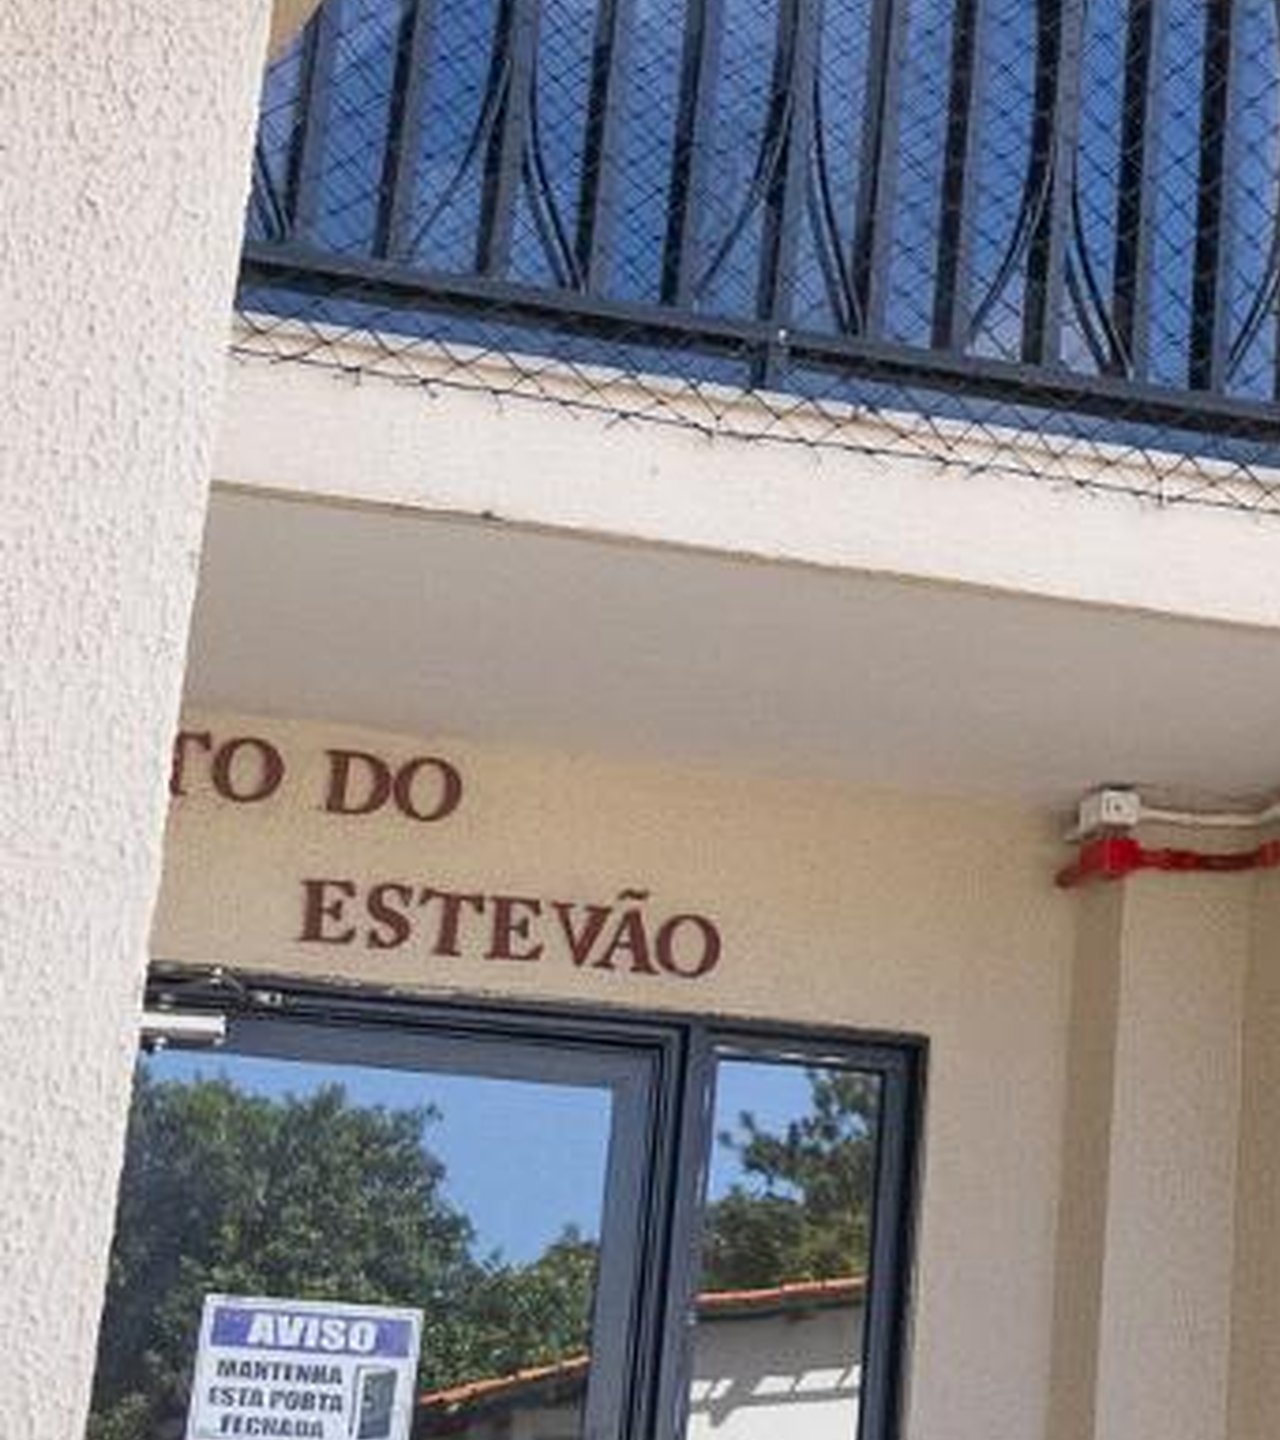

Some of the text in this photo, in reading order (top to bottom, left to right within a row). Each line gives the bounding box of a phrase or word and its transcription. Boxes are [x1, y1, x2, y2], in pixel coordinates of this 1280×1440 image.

[324, 749, 463, 822] DO
[298, 879, 722, 979] ESTEVÃO
[247, 1312, 379, 1352] AVISO
[216, 1360, 343, 1385] MANTENHA
[209, 1387, 343, 1413] ESTA PORTA
[220, 1414, 324, 1439] FECHADA
